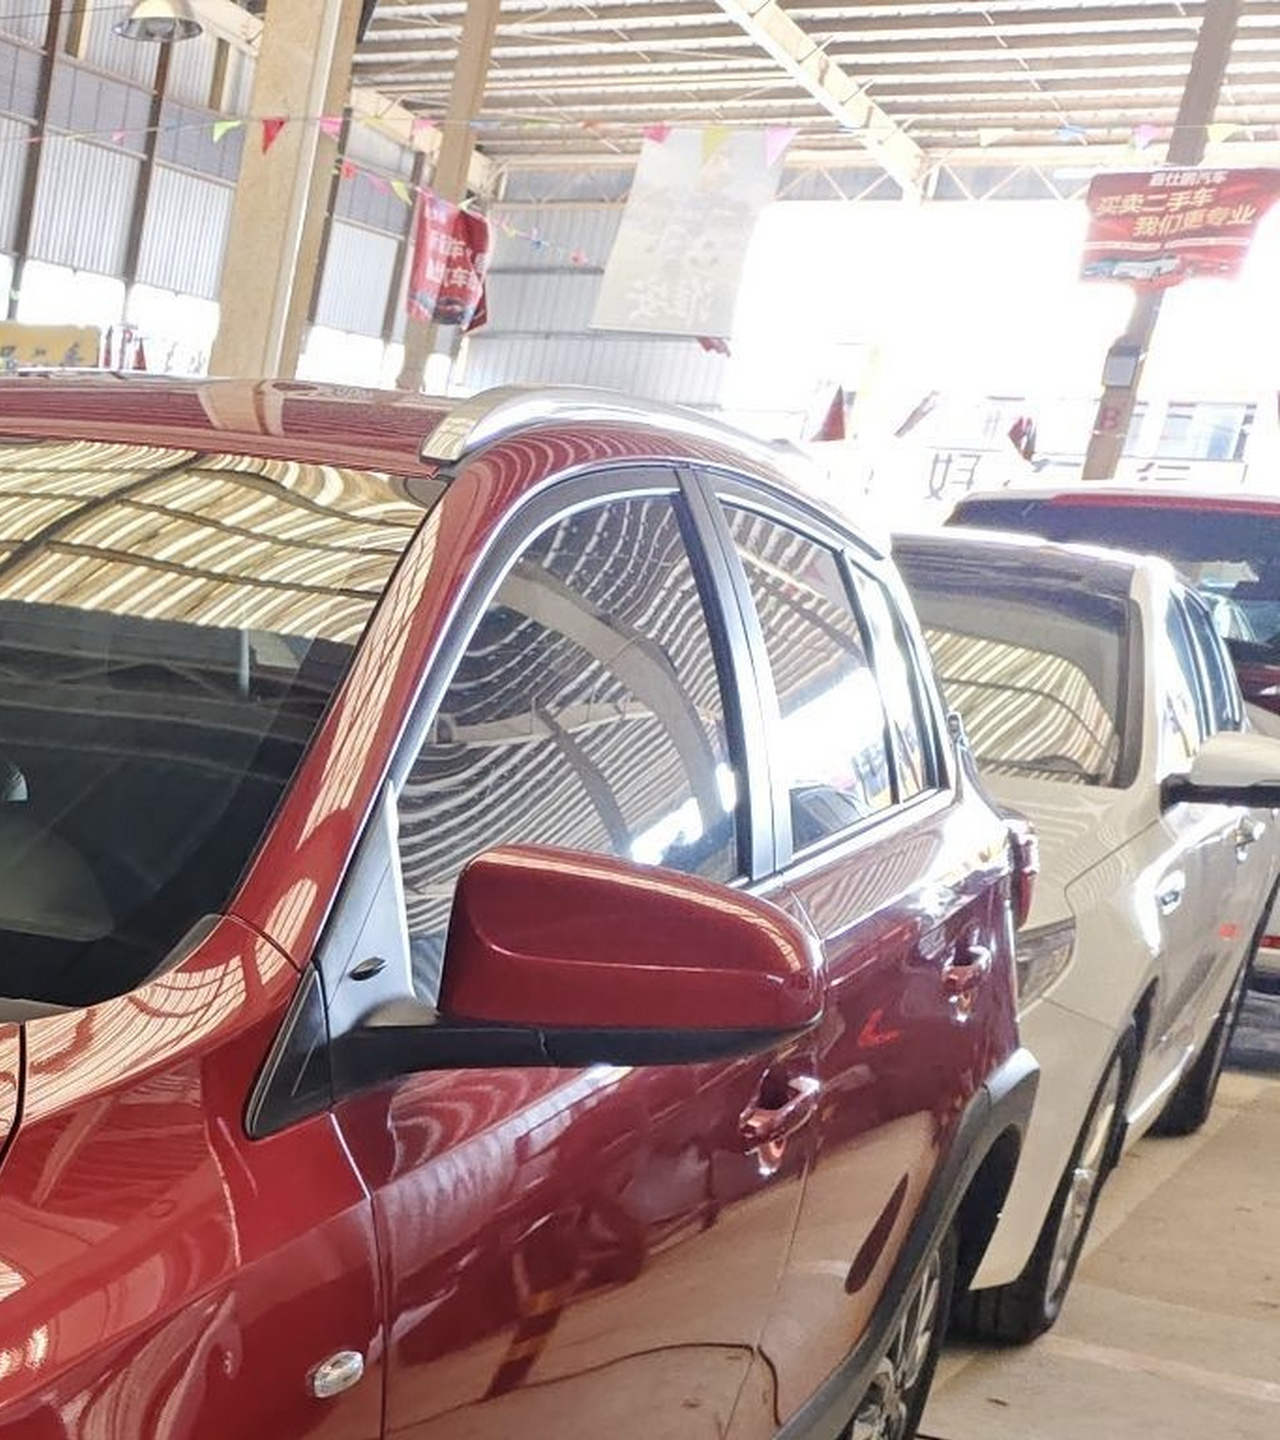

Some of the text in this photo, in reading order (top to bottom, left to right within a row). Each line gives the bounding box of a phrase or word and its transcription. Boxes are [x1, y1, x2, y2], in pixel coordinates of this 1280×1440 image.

[1096, 187, 1217, 216] 买卖二手车
[1132, 204, 1256, 237] 我们更专业
